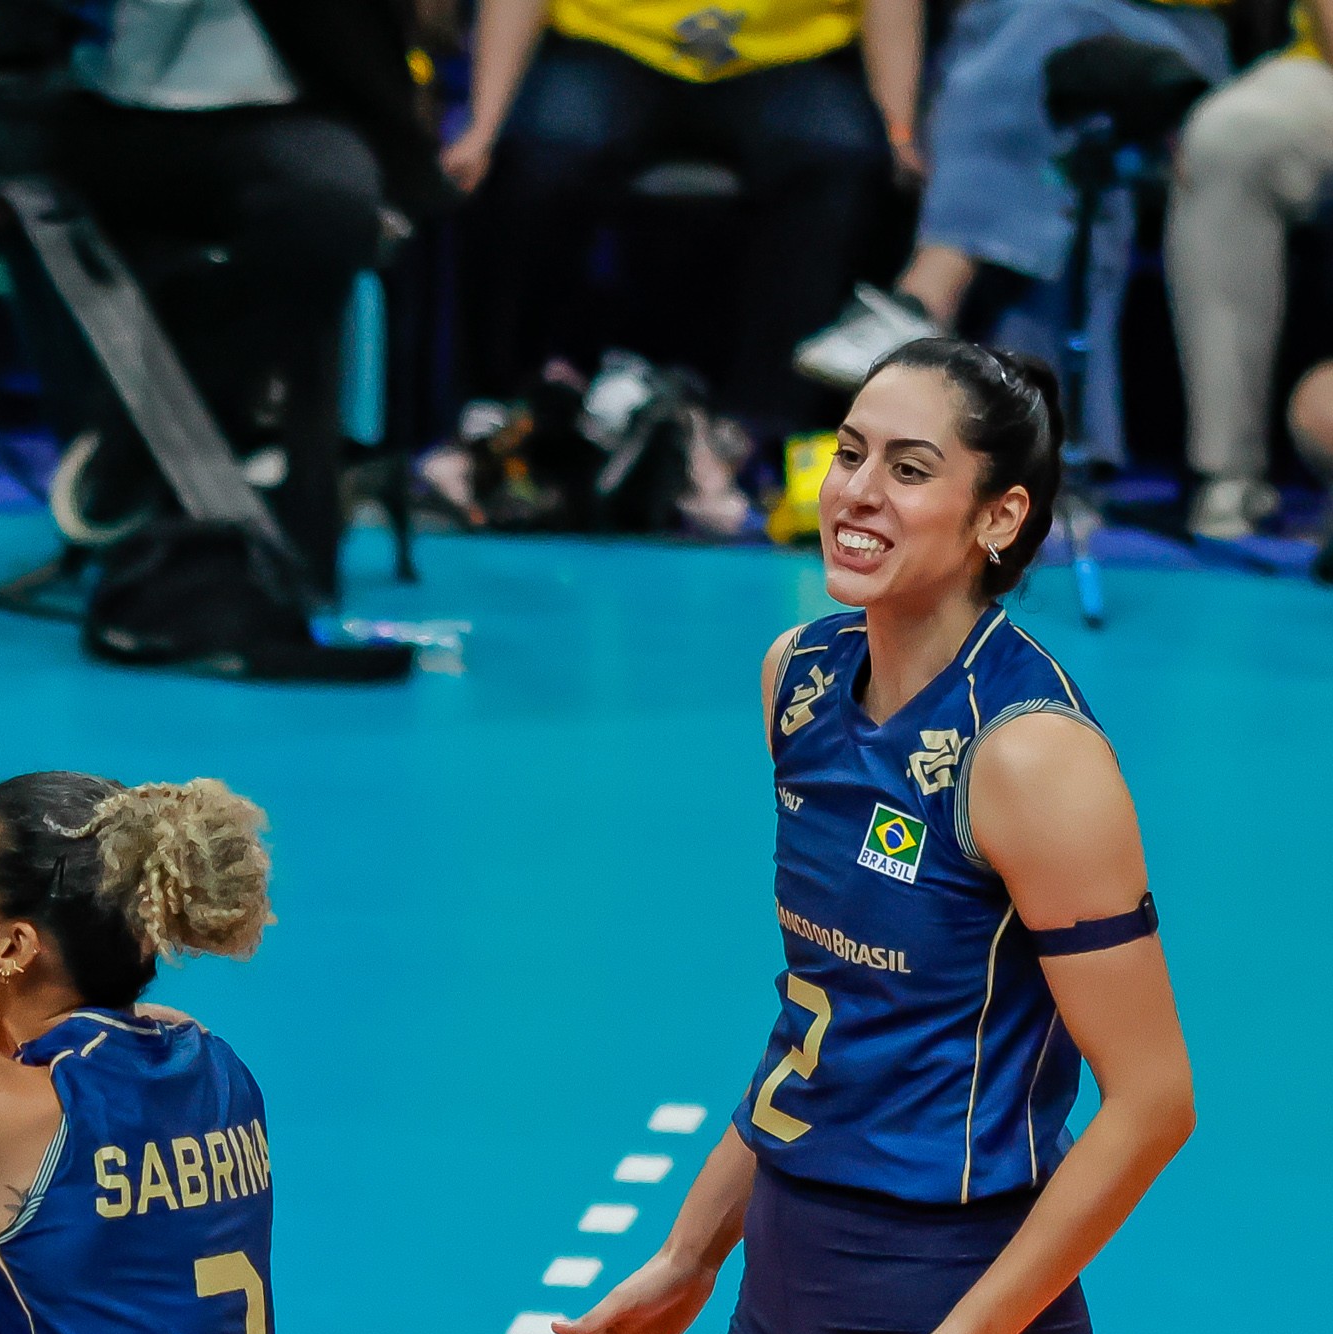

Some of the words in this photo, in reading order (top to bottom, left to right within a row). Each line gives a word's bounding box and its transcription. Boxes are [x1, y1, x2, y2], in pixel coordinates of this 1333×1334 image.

[860, 850, 912, 881] BRASIL
[812, 923, 832, 952] DO
[832, 928, 912, 974] BRASIL
[751, 972, 831, 1143] 2
[93, 1118, 271, 1219] SABRINA
